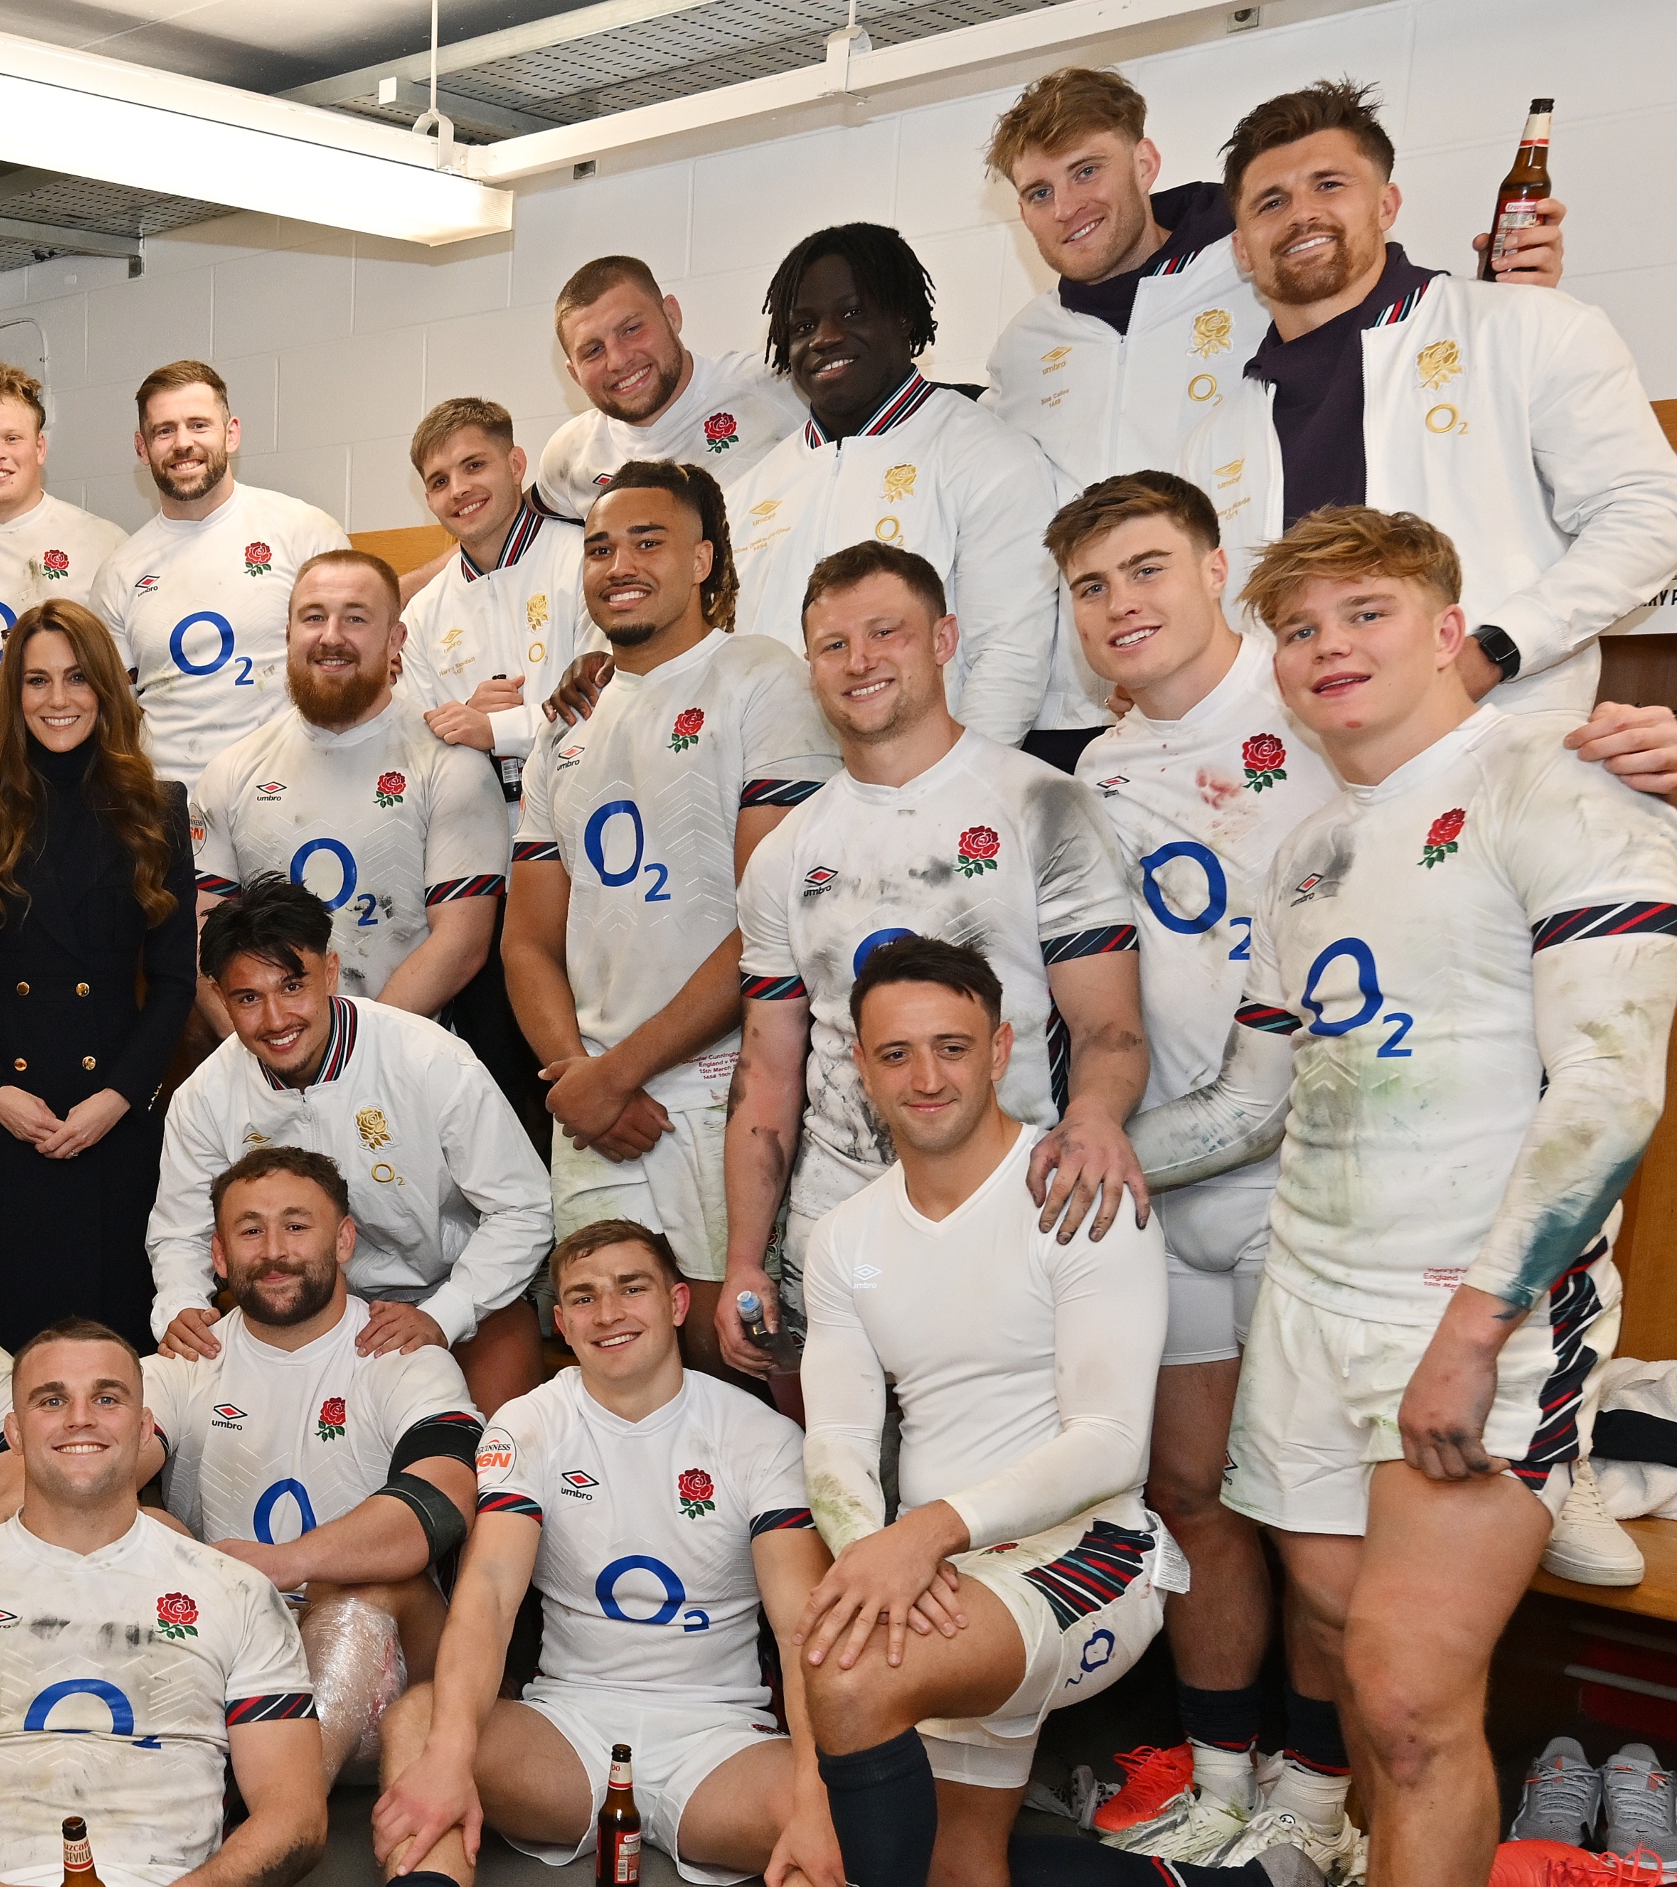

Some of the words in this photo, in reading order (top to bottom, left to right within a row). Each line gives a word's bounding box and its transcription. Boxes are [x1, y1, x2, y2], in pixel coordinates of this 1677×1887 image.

[170, 611, 254, 686] O2
[557, 759, 580, 771] umbro
[583, 800, 671, 903] O2
[804, 885, 831, 896] umbro
[1301, 938, 1413, 1058] O2
[372, 1162, 405, 1185] O2
[212, 1420, 242, 1431] umbro
[561, 1488, 592, 1501] umbro
